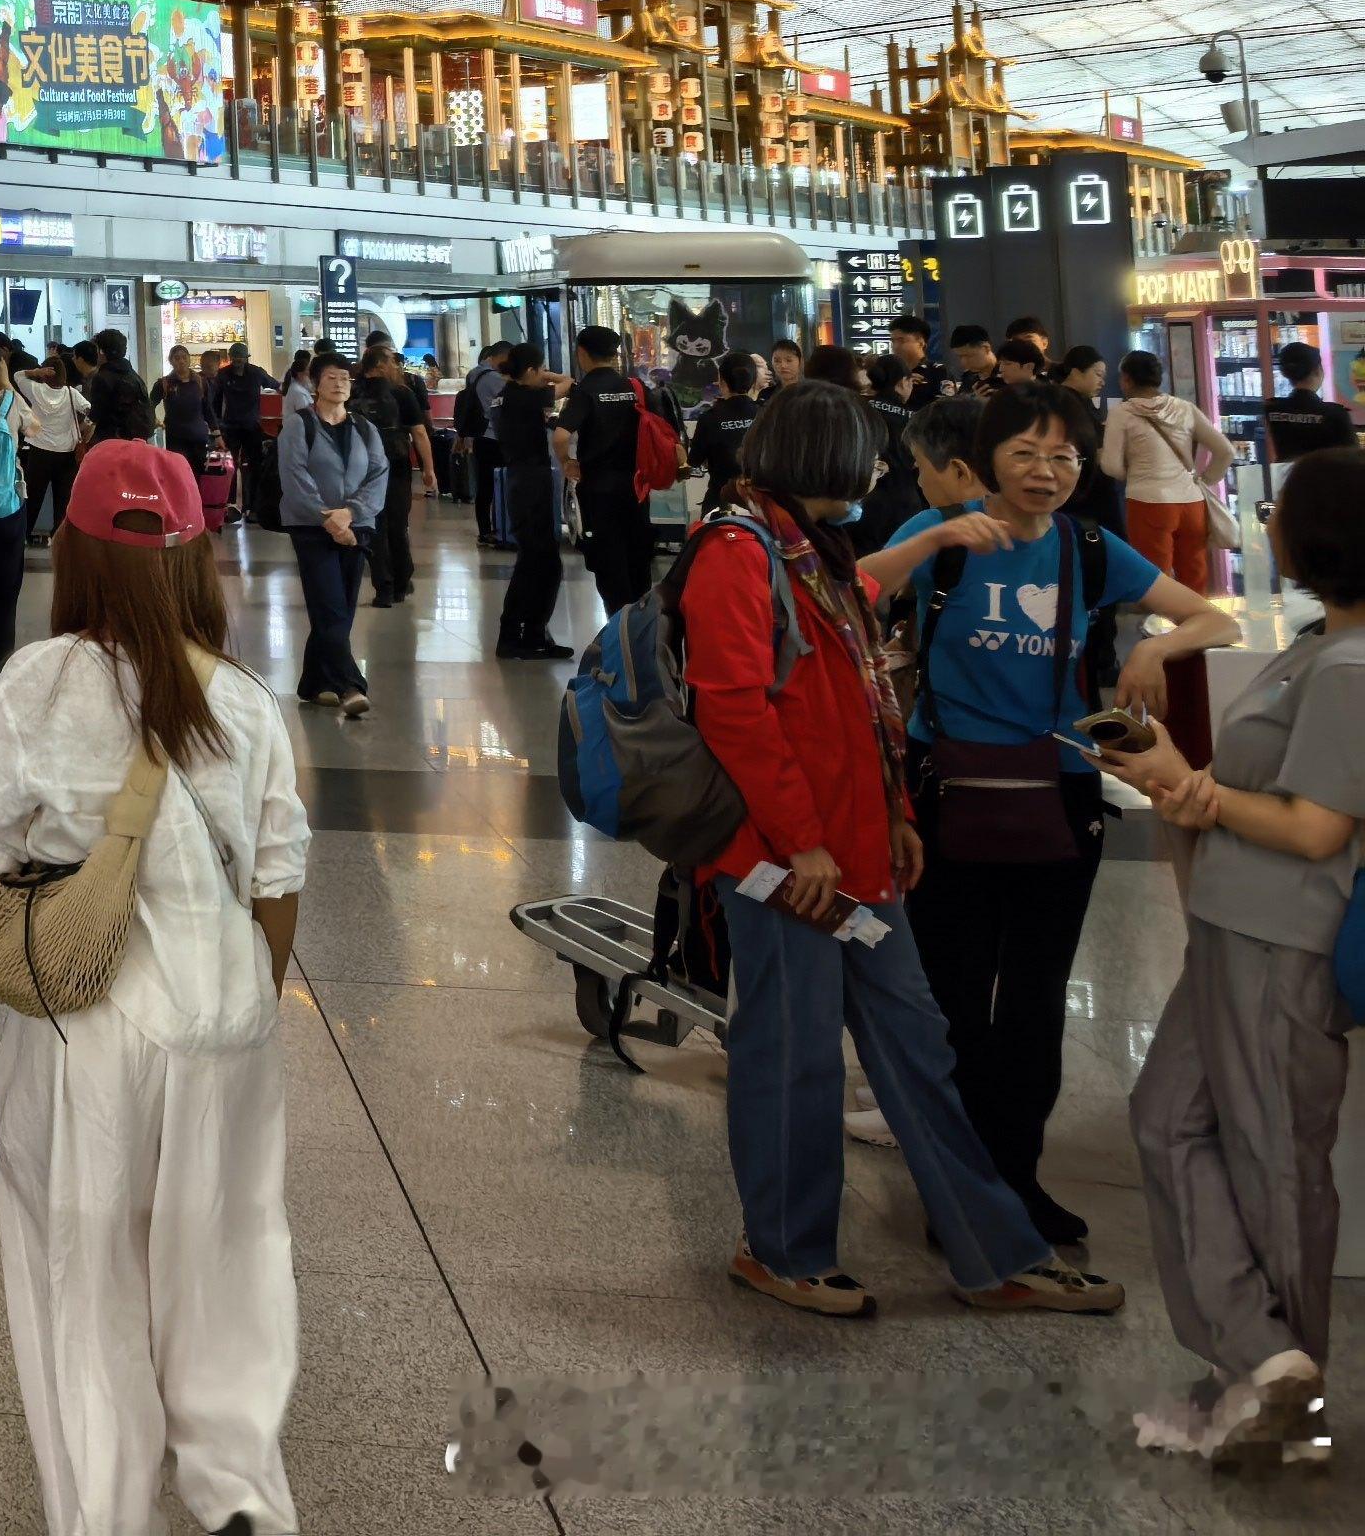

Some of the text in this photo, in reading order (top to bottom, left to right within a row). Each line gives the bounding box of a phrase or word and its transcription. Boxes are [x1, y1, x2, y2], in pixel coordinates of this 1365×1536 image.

[52, 1, 82, 25] 京韵
[21, 31, 148, 84] 文化美食节
[39, 87, 136, 103] Culture and Food Festival
[1137, 270, 1220, 305] POP MART
[720, 419, 755, 431] SECUR
[982, 582, 1007, 622] I
[1014, 633, 1081, 659] YONX
